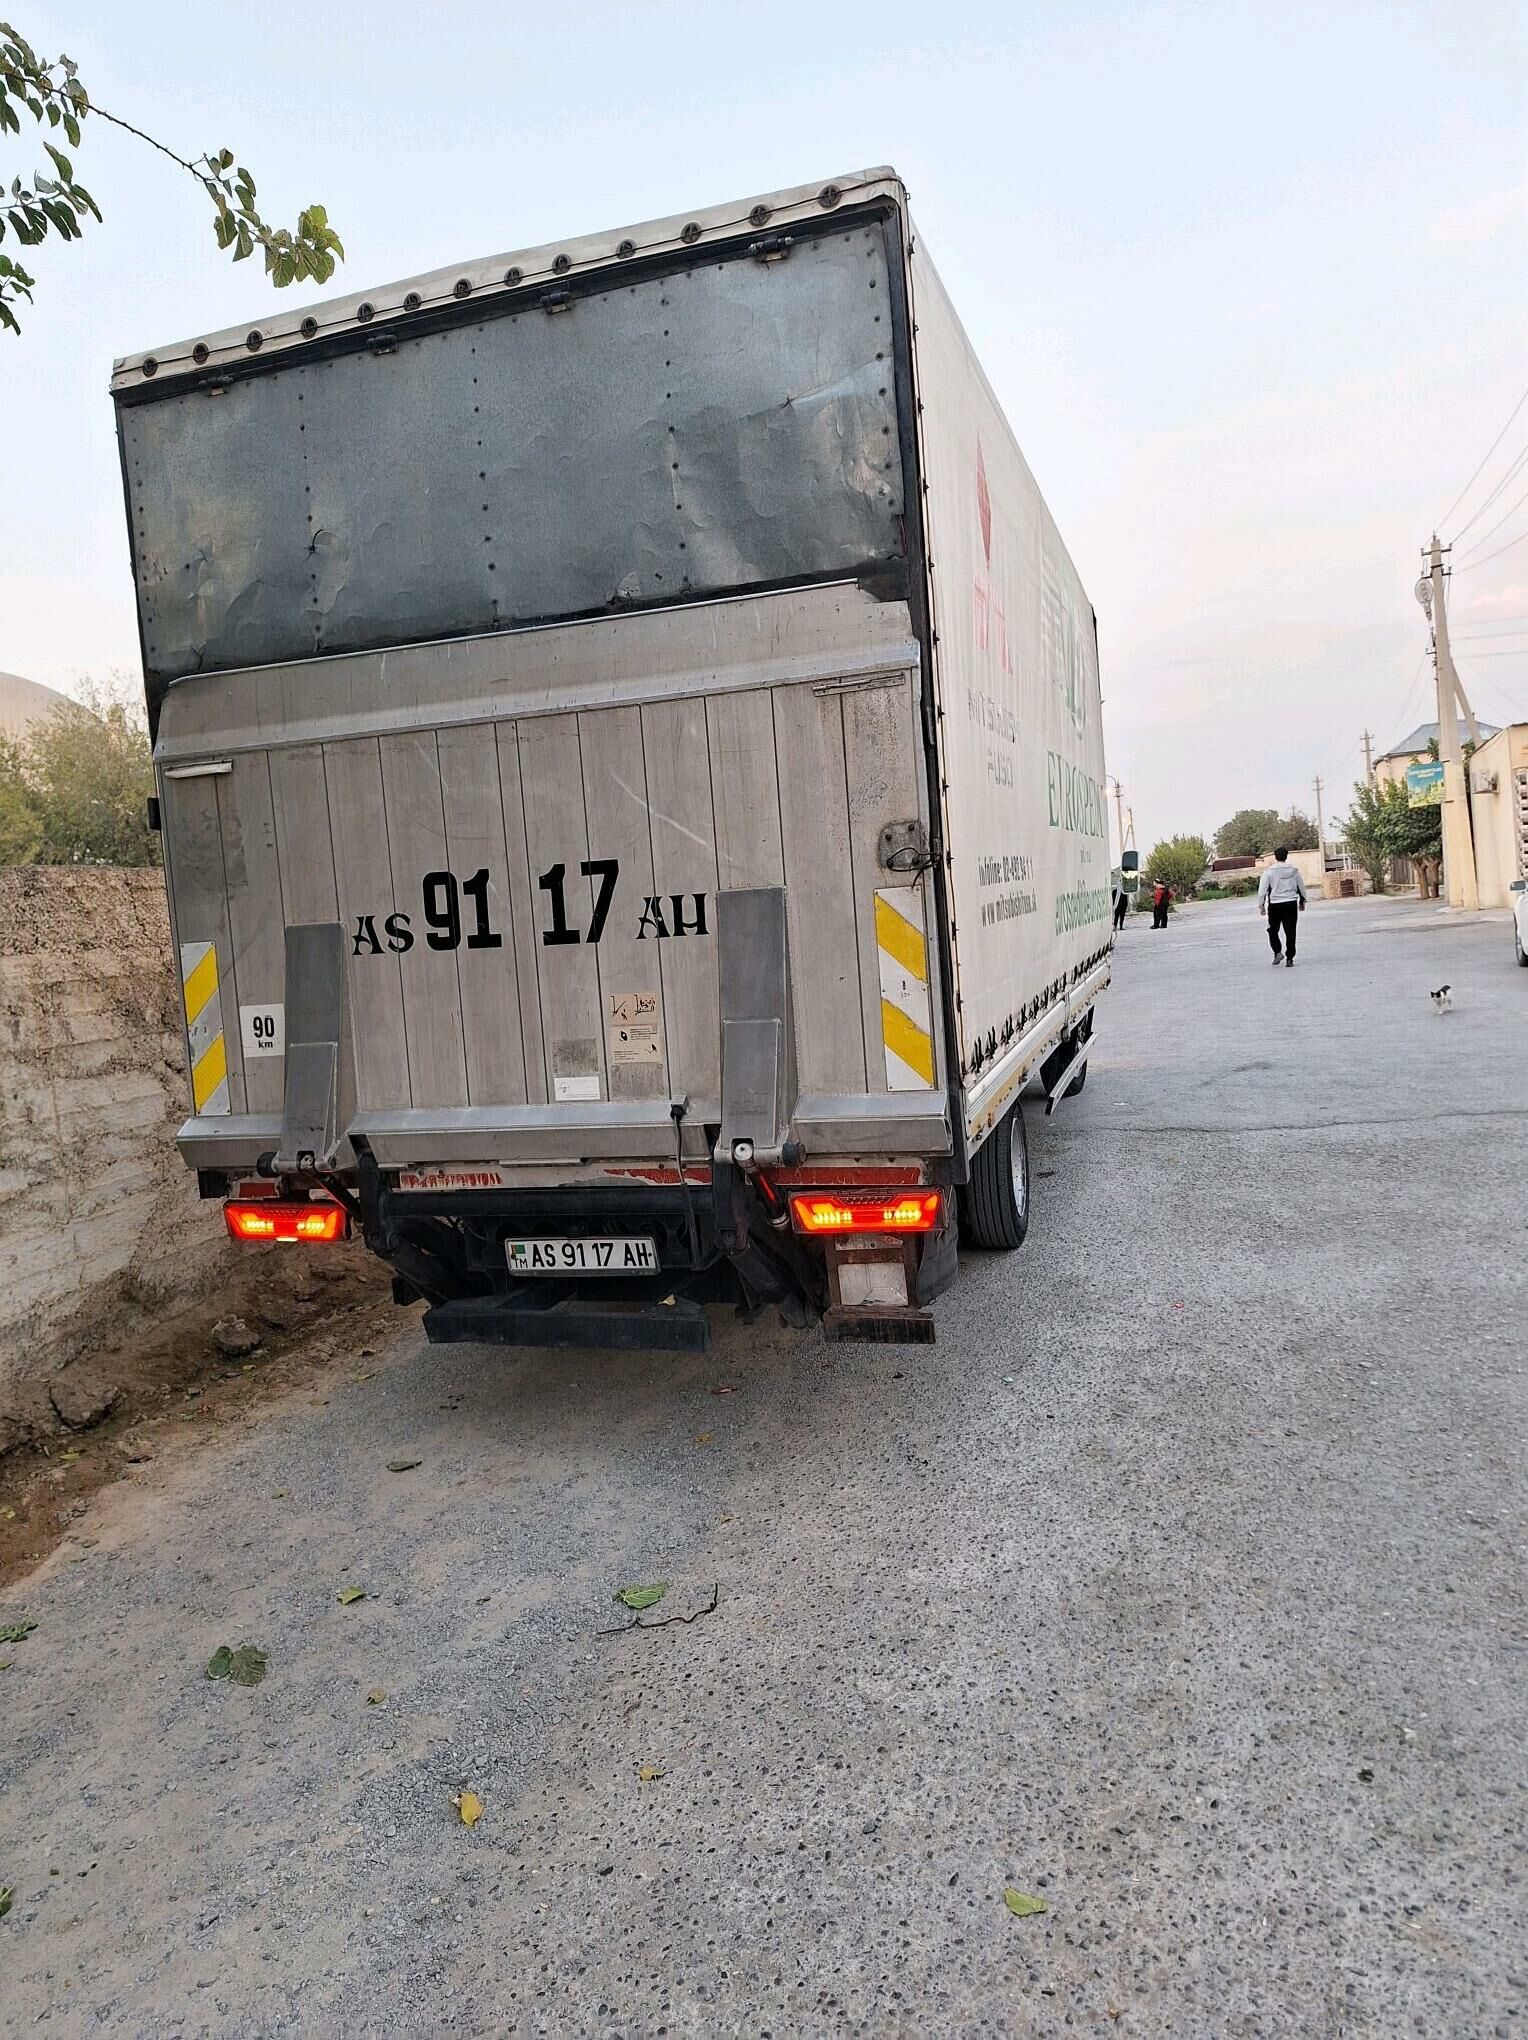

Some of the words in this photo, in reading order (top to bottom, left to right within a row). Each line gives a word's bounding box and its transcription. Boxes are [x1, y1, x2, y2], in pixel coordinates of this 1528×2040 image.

[352, 912, 415, 956] AS
[422, 868, 503, 951] 91
[538, 858, 620, 947] 17
[636, 892, 711, 940] AH
[253, 1015, 275, 1039] 90
[258, 1040, 274, 1049] km
[514, 1257, 528, 1269] TM
[532, 1243, 556, 1268] AS
[561, 1243, 586, 1268] 91
[591, 1243, 614, 1267] 17
[623, 1243, 650, 1267] AH
